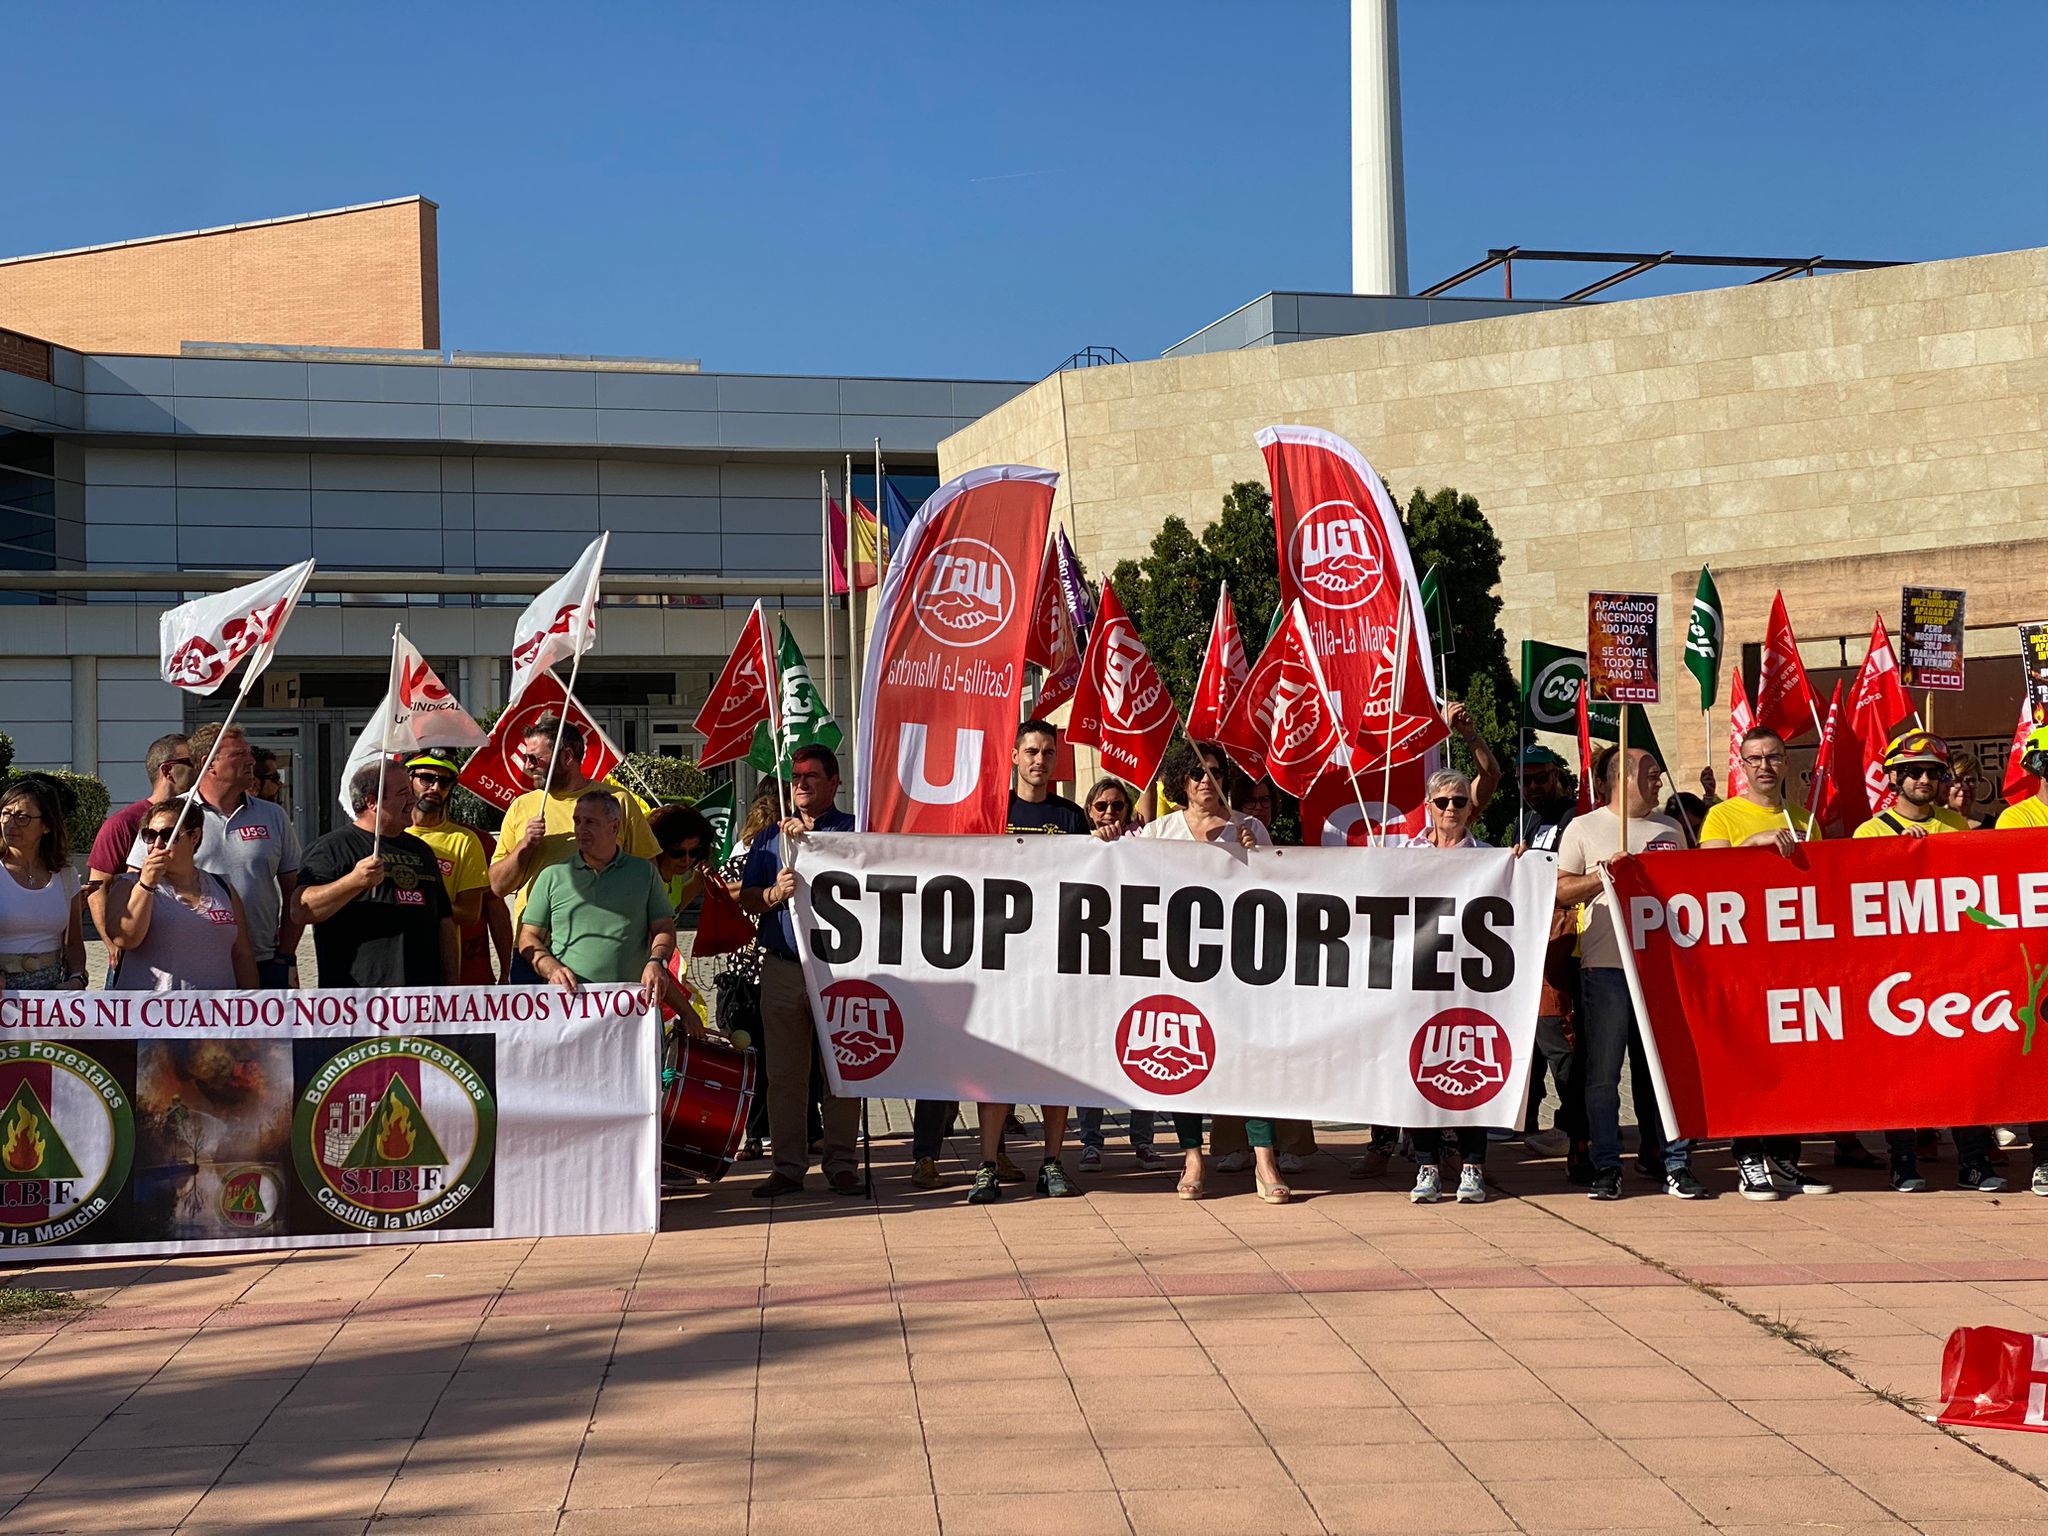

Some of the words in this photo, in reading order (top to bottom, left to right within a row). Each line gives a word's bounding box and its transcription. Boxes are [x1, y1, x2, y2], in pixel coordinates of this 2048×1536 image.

[1303, 518, 1368, 565] UGT
[1594, 600, 1655, 612] APAGANDO
[1911, 598, 1948, 608] INCENDIOS
[1949, 600, 1959, 609] SE
[1596, 612, 1654, 624] INCENDIOS
[1914, 607, 1944, 616] APAGAN
[1944, 608, 1955, 617] EN
[1601, 624, 1619, 633] 100
[1621, 624, 1649, 636] DIAS,
[1923, 624, 1943, 633] PERO
[1616, 636, 1633, 645] NO
[1914, 632, 1952, 642] NOSOTROS
[1923, 642, 1942, 650] SOLO
[1601, 647, 1613, 656] SE
[1615, 647, 1648, 658] COME
[1909, 649, 1957, 659] TRABAJAMOS
[1602, 658, 1634, 668] TODO
[1636, 659, 1648, 669] EL
[1912, 658, 1923, 666] EN
[1924, 659, 1953, 668] VERANO
[1103, 625, 1146, 714] UGT
[1607, 668, 1632, 679] AÑO
[1634, 671, 1643, 680] !!!
[1921, 673, 1960, 686] CCOO
[1615, 687, 1656, 698] CCOO
[240, 826, 267, 837] USO
[397, 890, 423, 902] USO
[1630, 891, 1746, 950] POR
[1765, 886, 1835, 942] EL
[1850, 872, 2048, 937] EMPLE
[810, 870, 1033, 971] STOP
[1057, 881, 1515, 993] RECORTES
[94, 998, 131, 1027] NI
[140, 998, 285, 1027] CUANDO
[293, 996, 358, 1026] NOS
[366, 992, 550, 1031] QUEMAMOS
[558, 989, 650, 1019] VIVOS
[1766, 986, 1843, 1044] EN
[822, 997, 890, 1037] UGT
[1128, 1010, 1202, 1051] UGT
[1423, 1025, 1498, 1066] UGT
[29, 1042, 123, 1109] Forestales
[305, 1040, 391, 1105] Bomberos
[398, 1037, 485, 1101] Forestales
[341, 1167, 446, 1194] S.I.B.F.
[317, 1187, 378, 1229] Castilla
[384, 1214, 400, 1229] la
[405, 1182, 471, 1227] Mancha
[11, 1229, 29, 1245] la
[35, 1197, 108, 1243] Mancha
